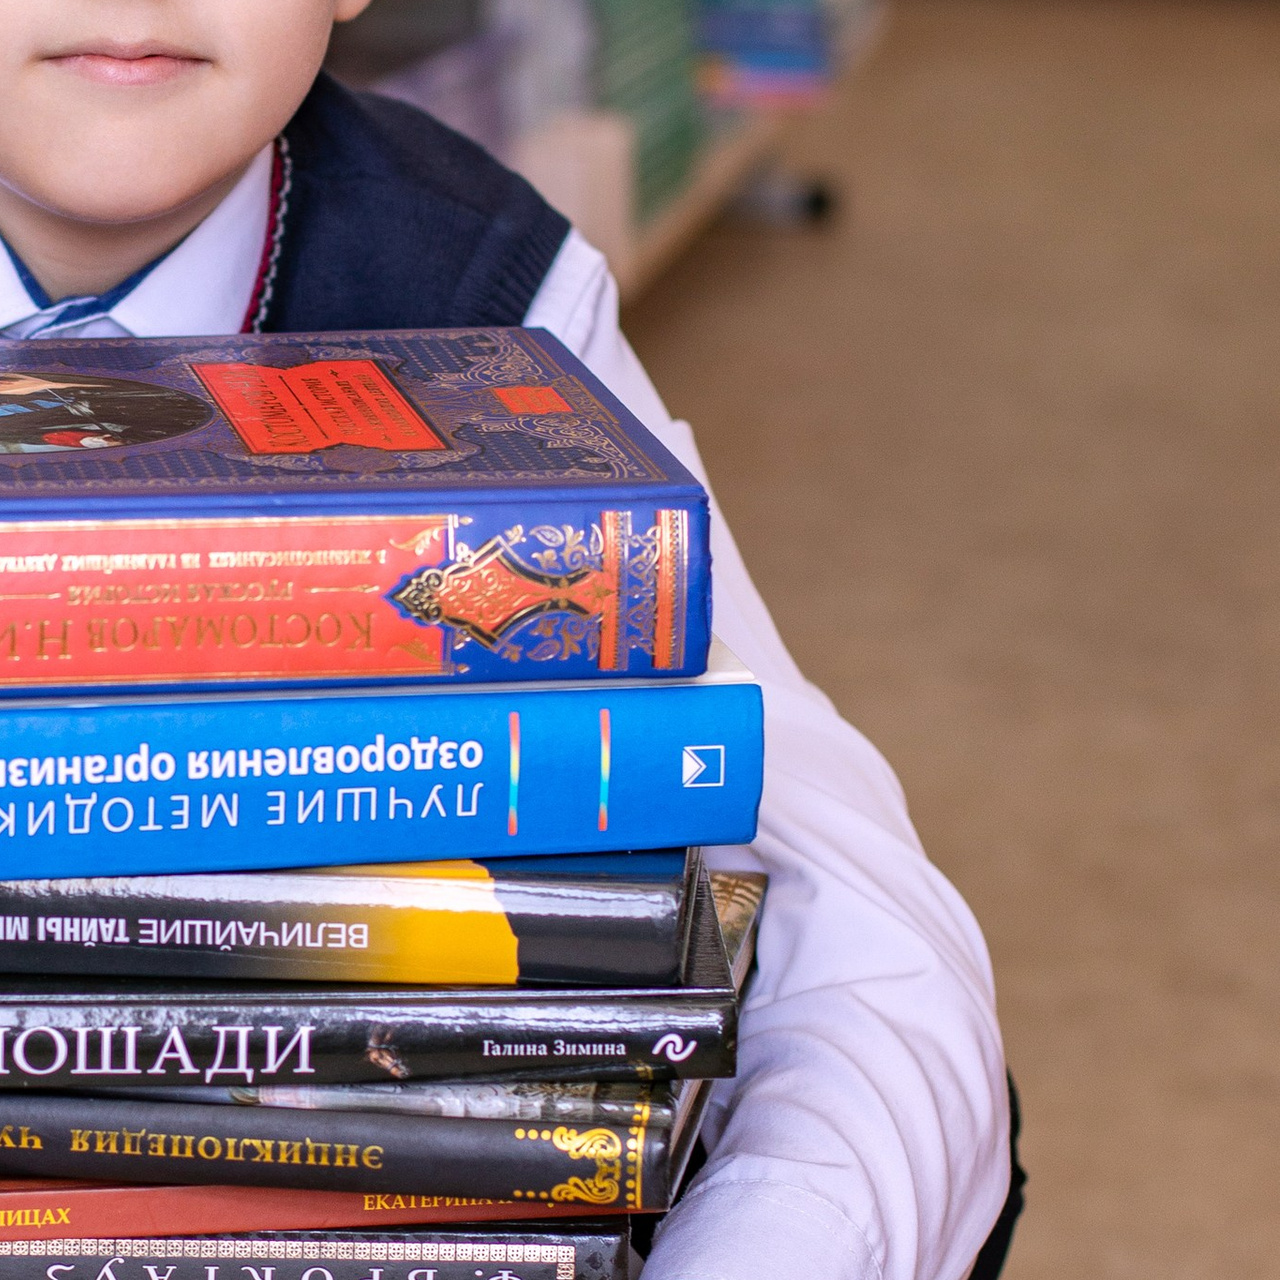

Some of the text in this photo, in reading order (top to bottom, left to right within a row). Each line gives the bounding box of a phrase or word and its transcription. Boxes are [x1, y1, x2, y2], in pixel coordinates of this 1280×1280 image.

[68, 579, 294, 606] РУССКАЯ ИСТОРИЯ
[87, 612, 375, 654] КОСТОМАРОВ
[187, 734, 484, 781] оздоровления
[266, 781, 484, 826] ЛУЧШИЕ
[37, 916, 129, 948] ТАЙНЫ
[138, 918, 370, 951] ВЕЛИЧАЙШИЕ
[482, 1039, 626, 1057] Галина Зимина
[69, 1128, 385, 1170] ЭНЦИКЛОПЕДИЯ
